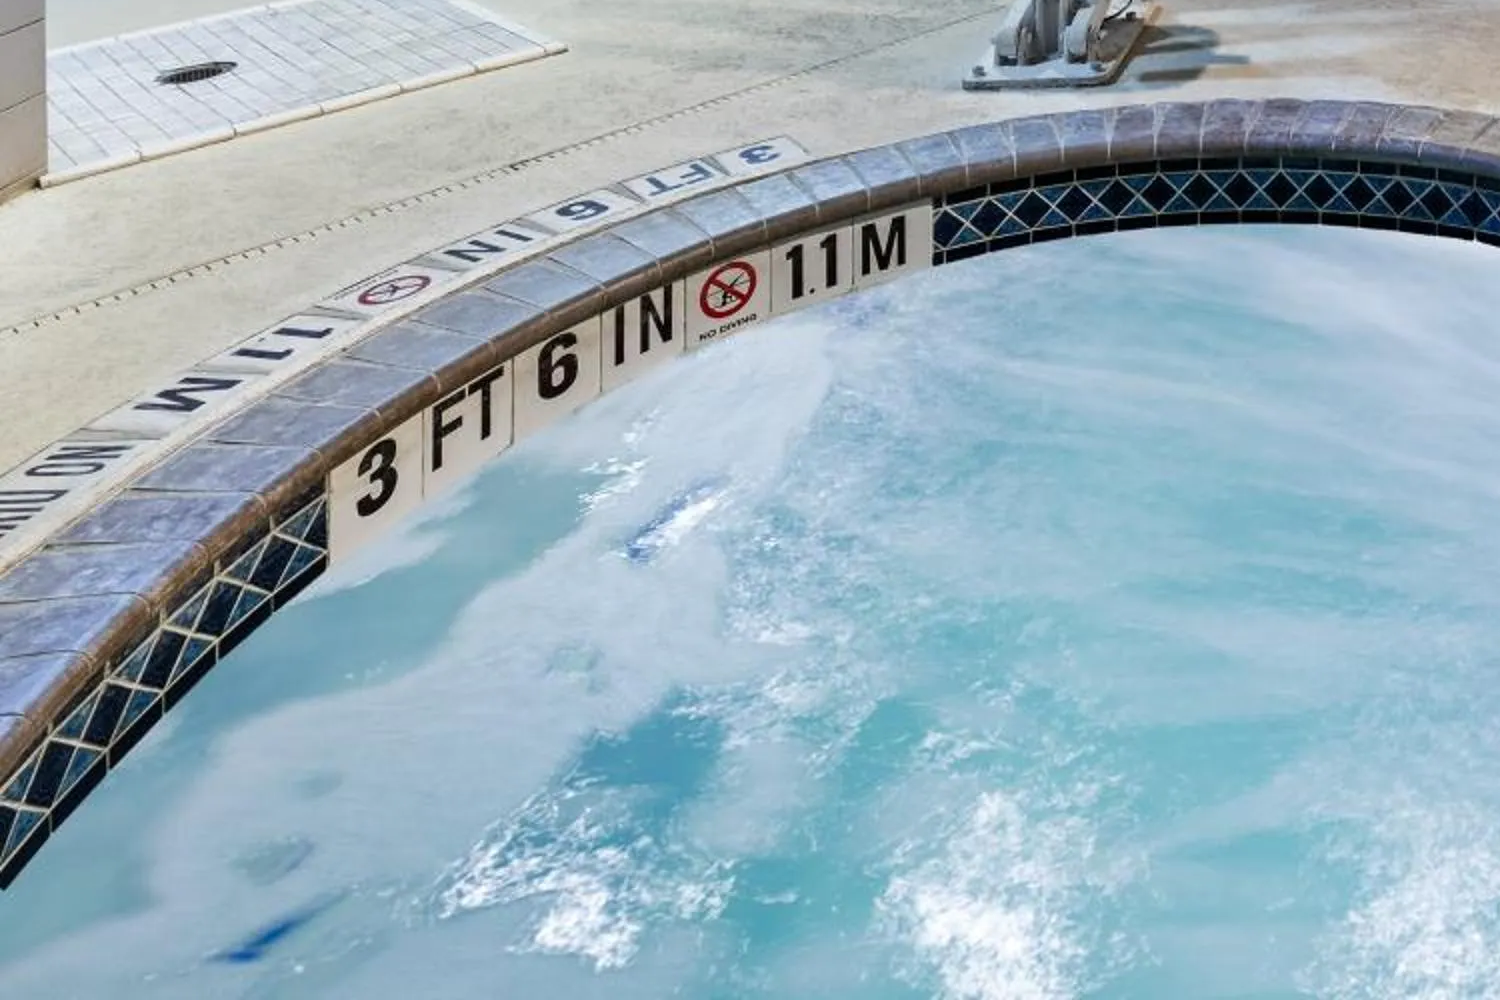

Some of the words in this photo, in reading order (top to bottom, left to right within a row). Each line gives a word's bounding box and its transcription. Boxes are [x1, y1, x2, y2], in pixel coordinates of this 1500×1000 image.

[738, 144, 781, 165] 3
[649, 163, 714, 197] FT
[555, 199, 609, 222] 6
[443, 229, 533, 262] IN
[786, 233, 838, 300] 1.1
[861, 215, 907, 277] M
[699, 329, 717, 341] NO
[719, 313, 757, 333] DIVING
[230, 327, 334, 361] 1.1
[132, 377, 244, 412] M
[356, 438, 399, 517] 3
[432, 366, 505, 473] FT
[537, 331, 579, 400] 6
[613, 284, 673, 367] IN
[24, 445, 132, 477] NO
